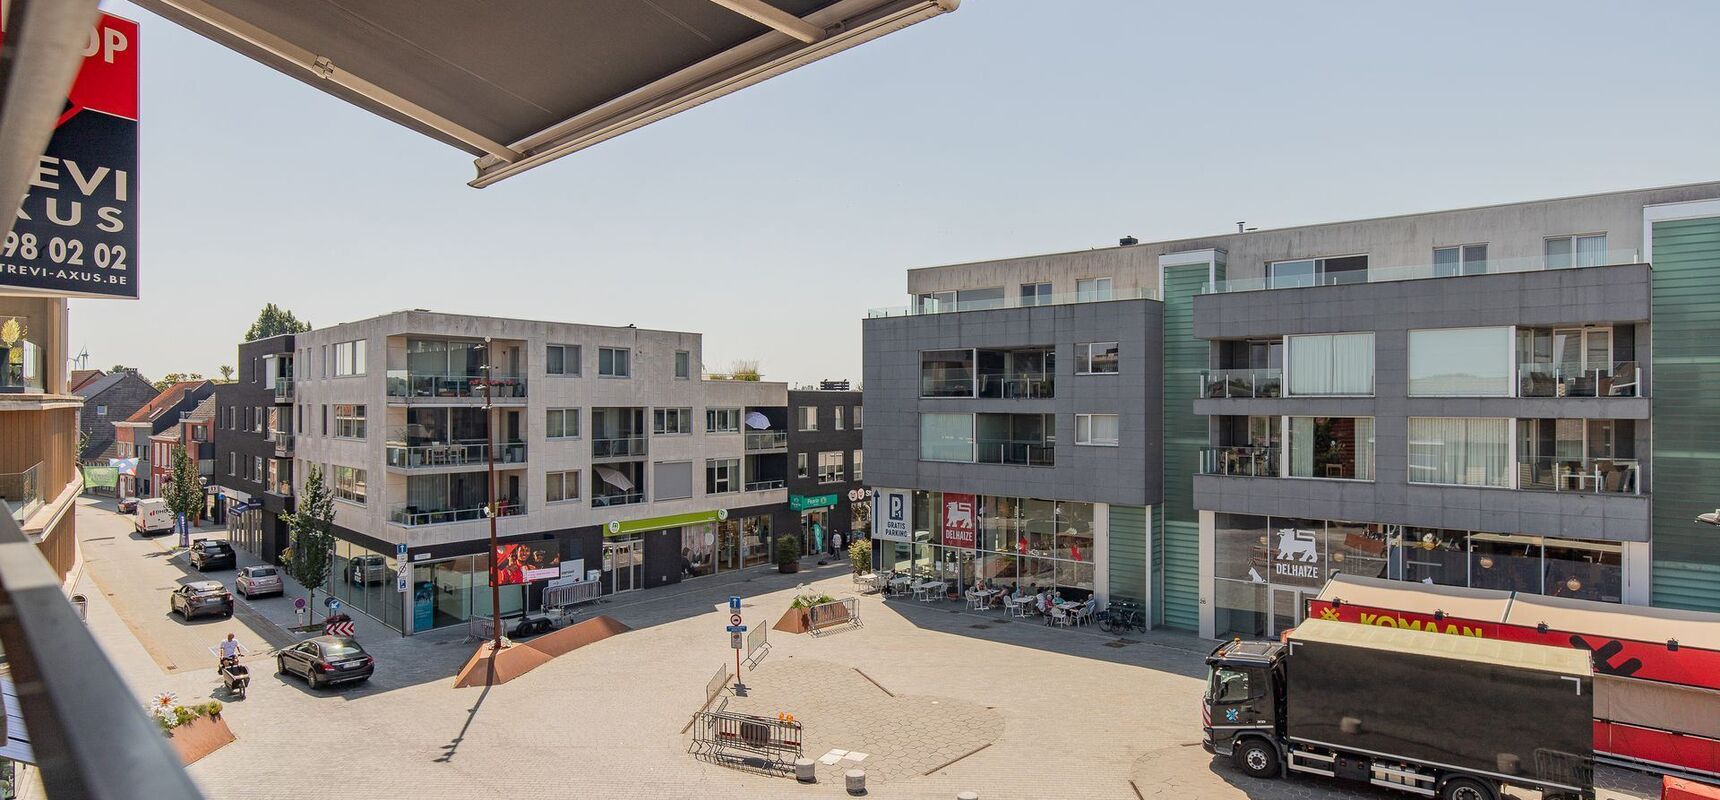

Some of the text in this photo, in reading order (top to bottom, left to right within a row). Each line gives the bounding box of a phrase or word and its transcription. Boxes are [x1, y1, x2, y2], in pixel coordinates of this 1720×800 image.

[29, 155, 127, 202] EVI
[48, 236, 84, 266] 02
[93, 242, 127, 271] 02
[887, 521, 906, 530] GRATIS
[885, 528, 908, 538] PARKING
[945, 529, 973, 542] DELHAIZE
[1276, 563, 1319, 579] DELHAIZE
